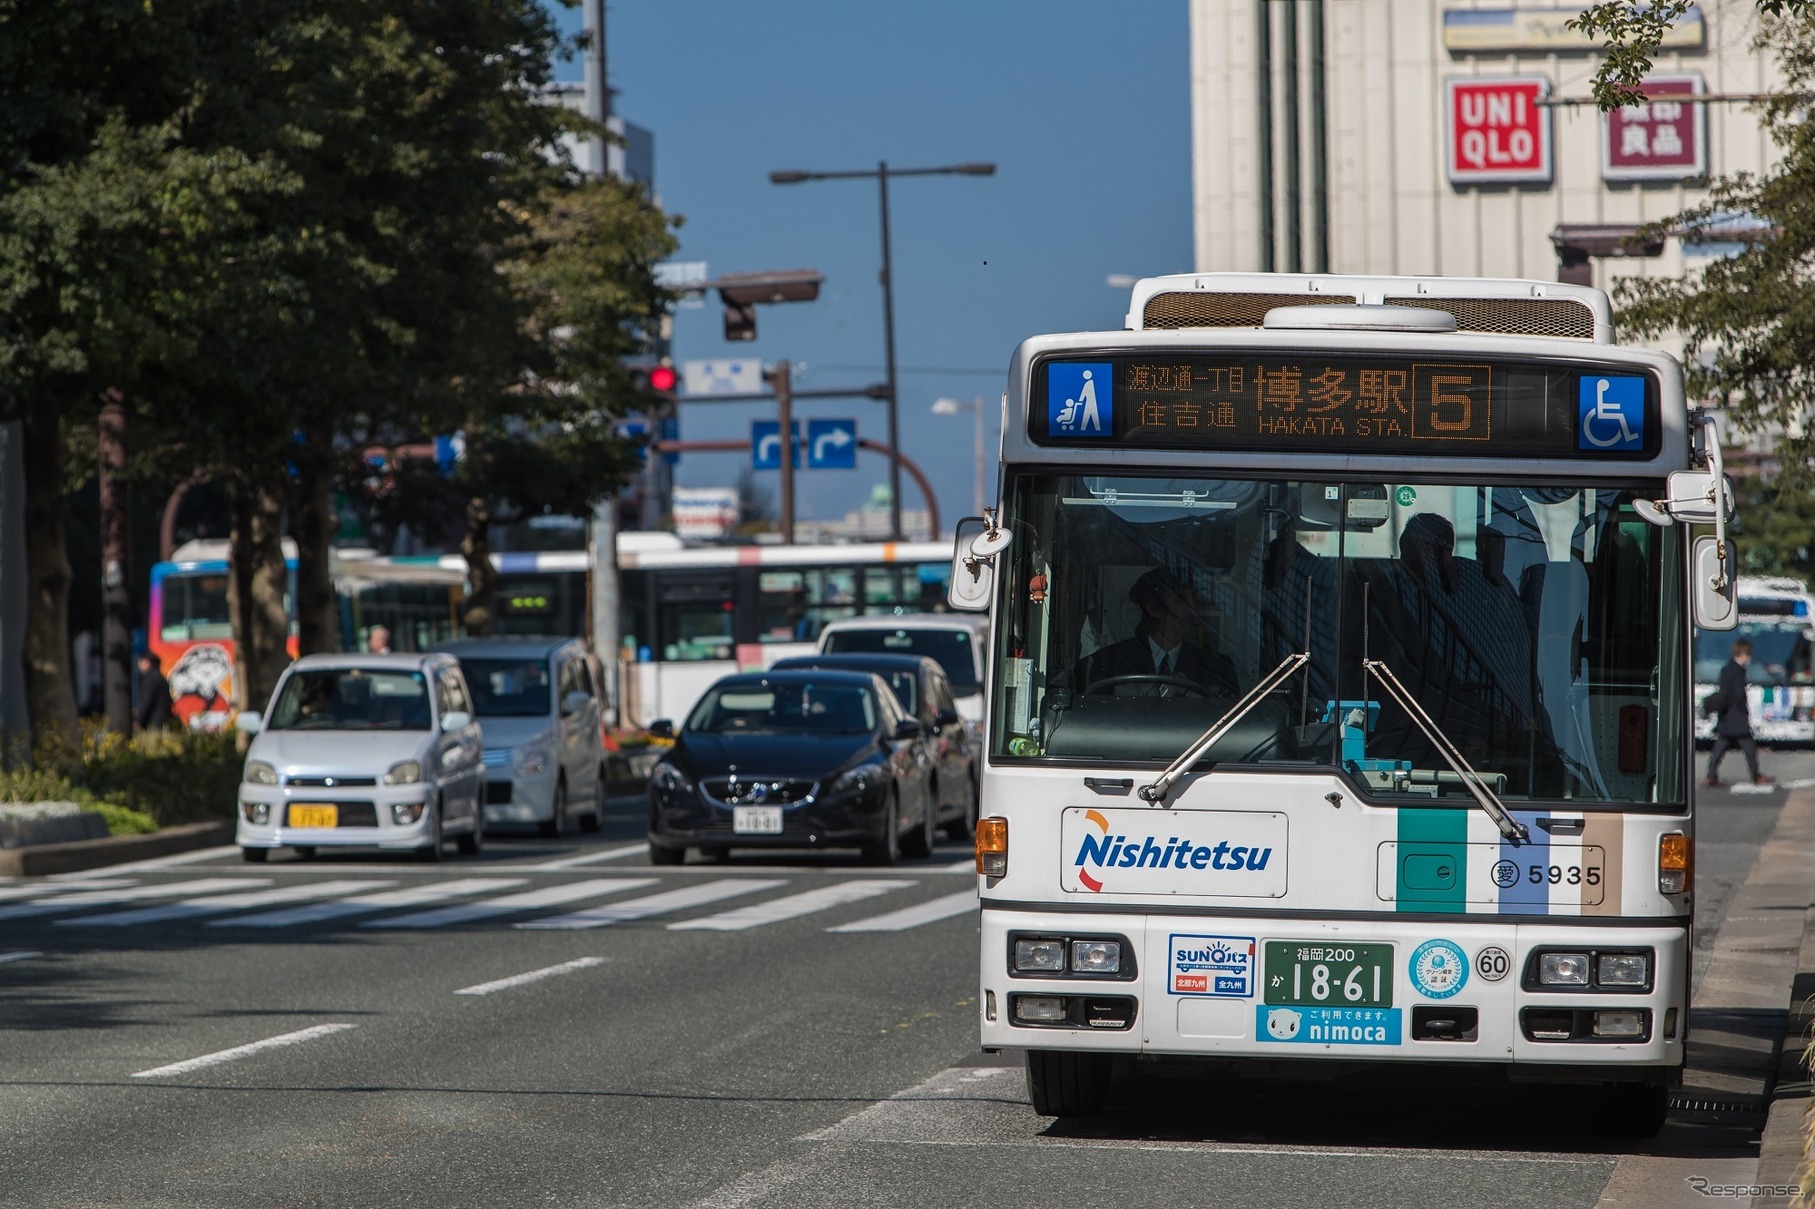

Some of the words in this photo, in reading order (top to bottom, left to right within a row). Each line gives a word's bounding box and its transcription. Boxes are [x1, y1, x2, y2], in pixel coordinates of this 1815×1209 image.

[1461, 92, 1527, 127] UNI
[1461, 128, 1534, 170] QLO
[1621, 124, 1682, 157] 良品
[1253, 365, 1408, 414] 博多駅
[1431, 375, 1472, 431] 5
[1138, 400, 1236, 427] 住吉通
[1259, 415, 1345, 436] HAKATA
[1357, 417, 1408, 437] STA.
[1074, 833, 1272, 871] Nishitetsu
[1528, 865, 1601, 886] 5935
[1480, 955, 1507, 974] 60
[1177, 979, 1206, 988] 北部九州
[1218, 980, 1242, 990] 全九州
[1271, 974, 1284, 987] か
[1293, 963, 1380, 1002] 18-61
[1310, 1020, 1386, 1041] nimoca
